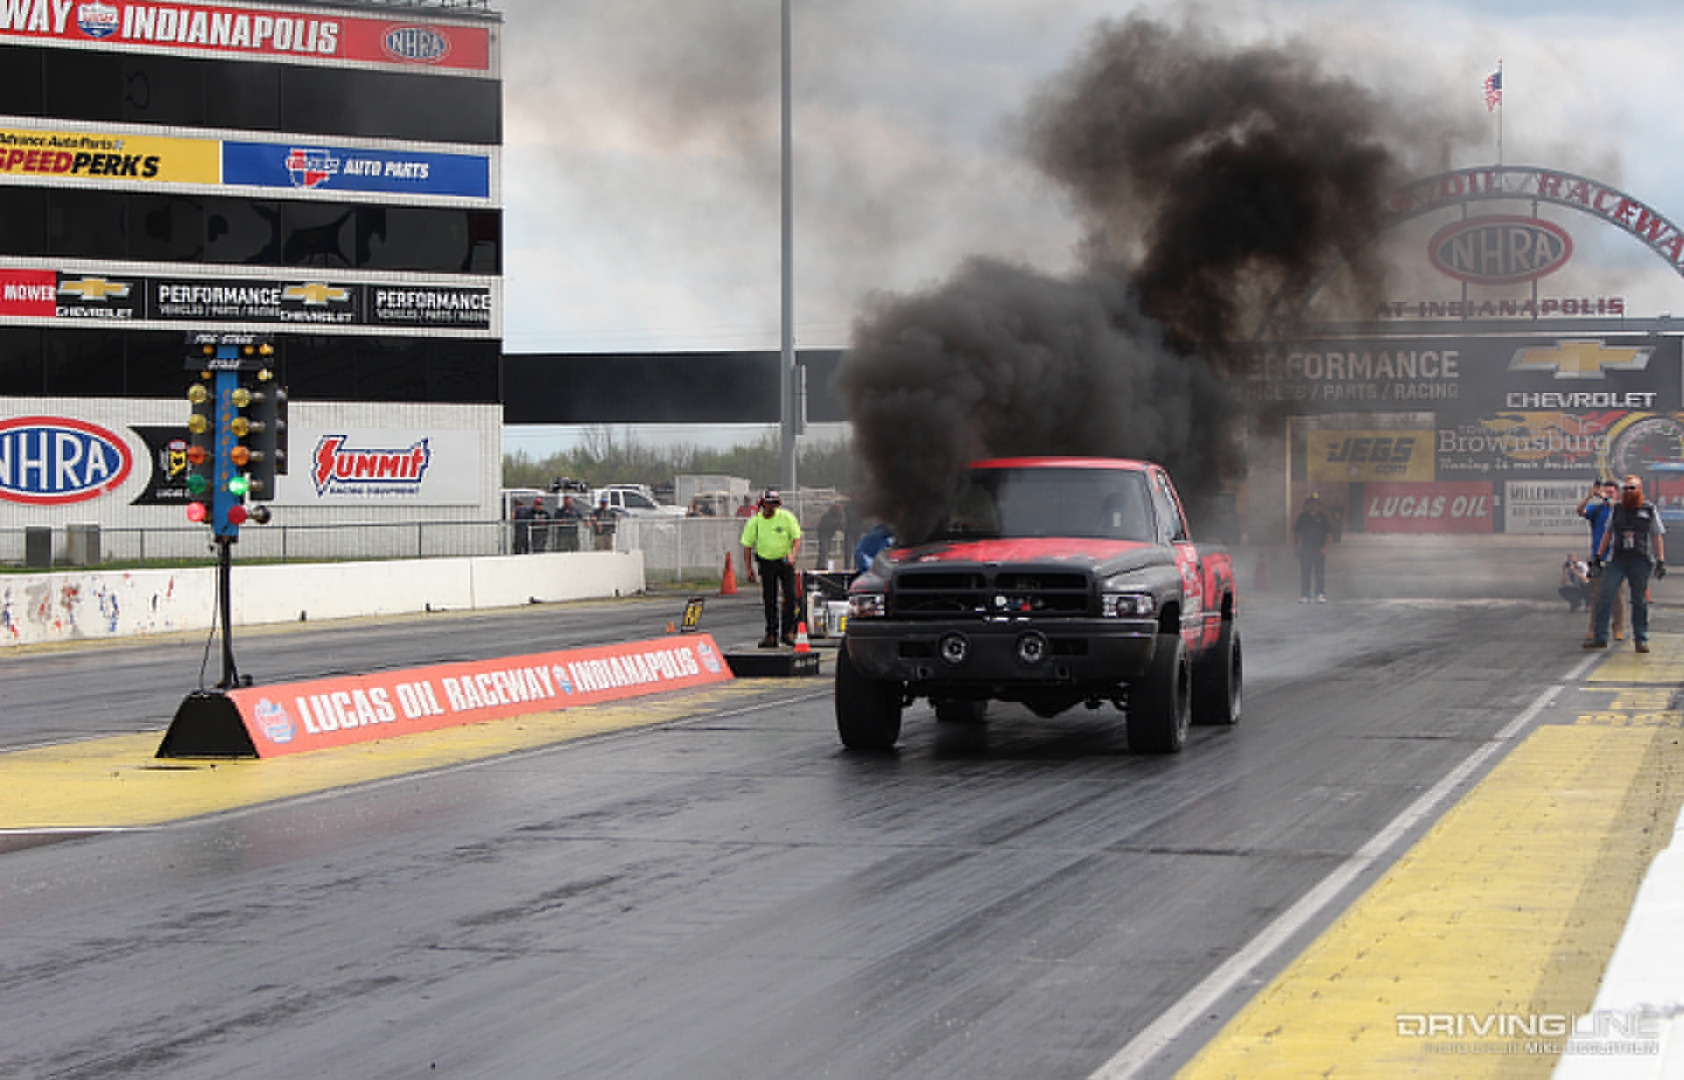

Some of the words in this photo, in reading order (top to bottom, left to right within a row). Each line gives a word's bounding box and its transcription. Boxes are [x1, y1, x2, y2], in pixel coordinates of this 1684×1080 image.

[121, 5, 339, 55] INDIANAPOLIS
[392, 29, 442, 58] NHRA
[49, 136, 78, 148] Auto
[80, 137, 114, 150] Parts
[344, 159, 382, 176] AUTO
[384, 161, 429, 179] PARTS
[1441, 170, 1502, 197] OIL
[1538, 172, 1684, 266] RACEWA
[1452, 227, 1552, 275] NHRA
[159, 284, 281, 305] PERFORMANCE
[376, 291, 492, 309] PERFORMANCE
[1420, 297, 1624, 318] INDIANAPOLIS
[1506, 392, 1657, 408] CHEVROLET
[1326, 437, 1416, 463] JEGS
[1438, 429, 1612, 456] Brownsburg
[1368, 495, 1444, 519] LUCAS
[1450, 495, 1490, 519] OIL
[295, 686, 397, 733] LUCAS
[395, 680, 444, 720] OIL
[442, 665, 556, 713] RACEWAY
[568, 647, 699, 693] INDIANAPOLIS
